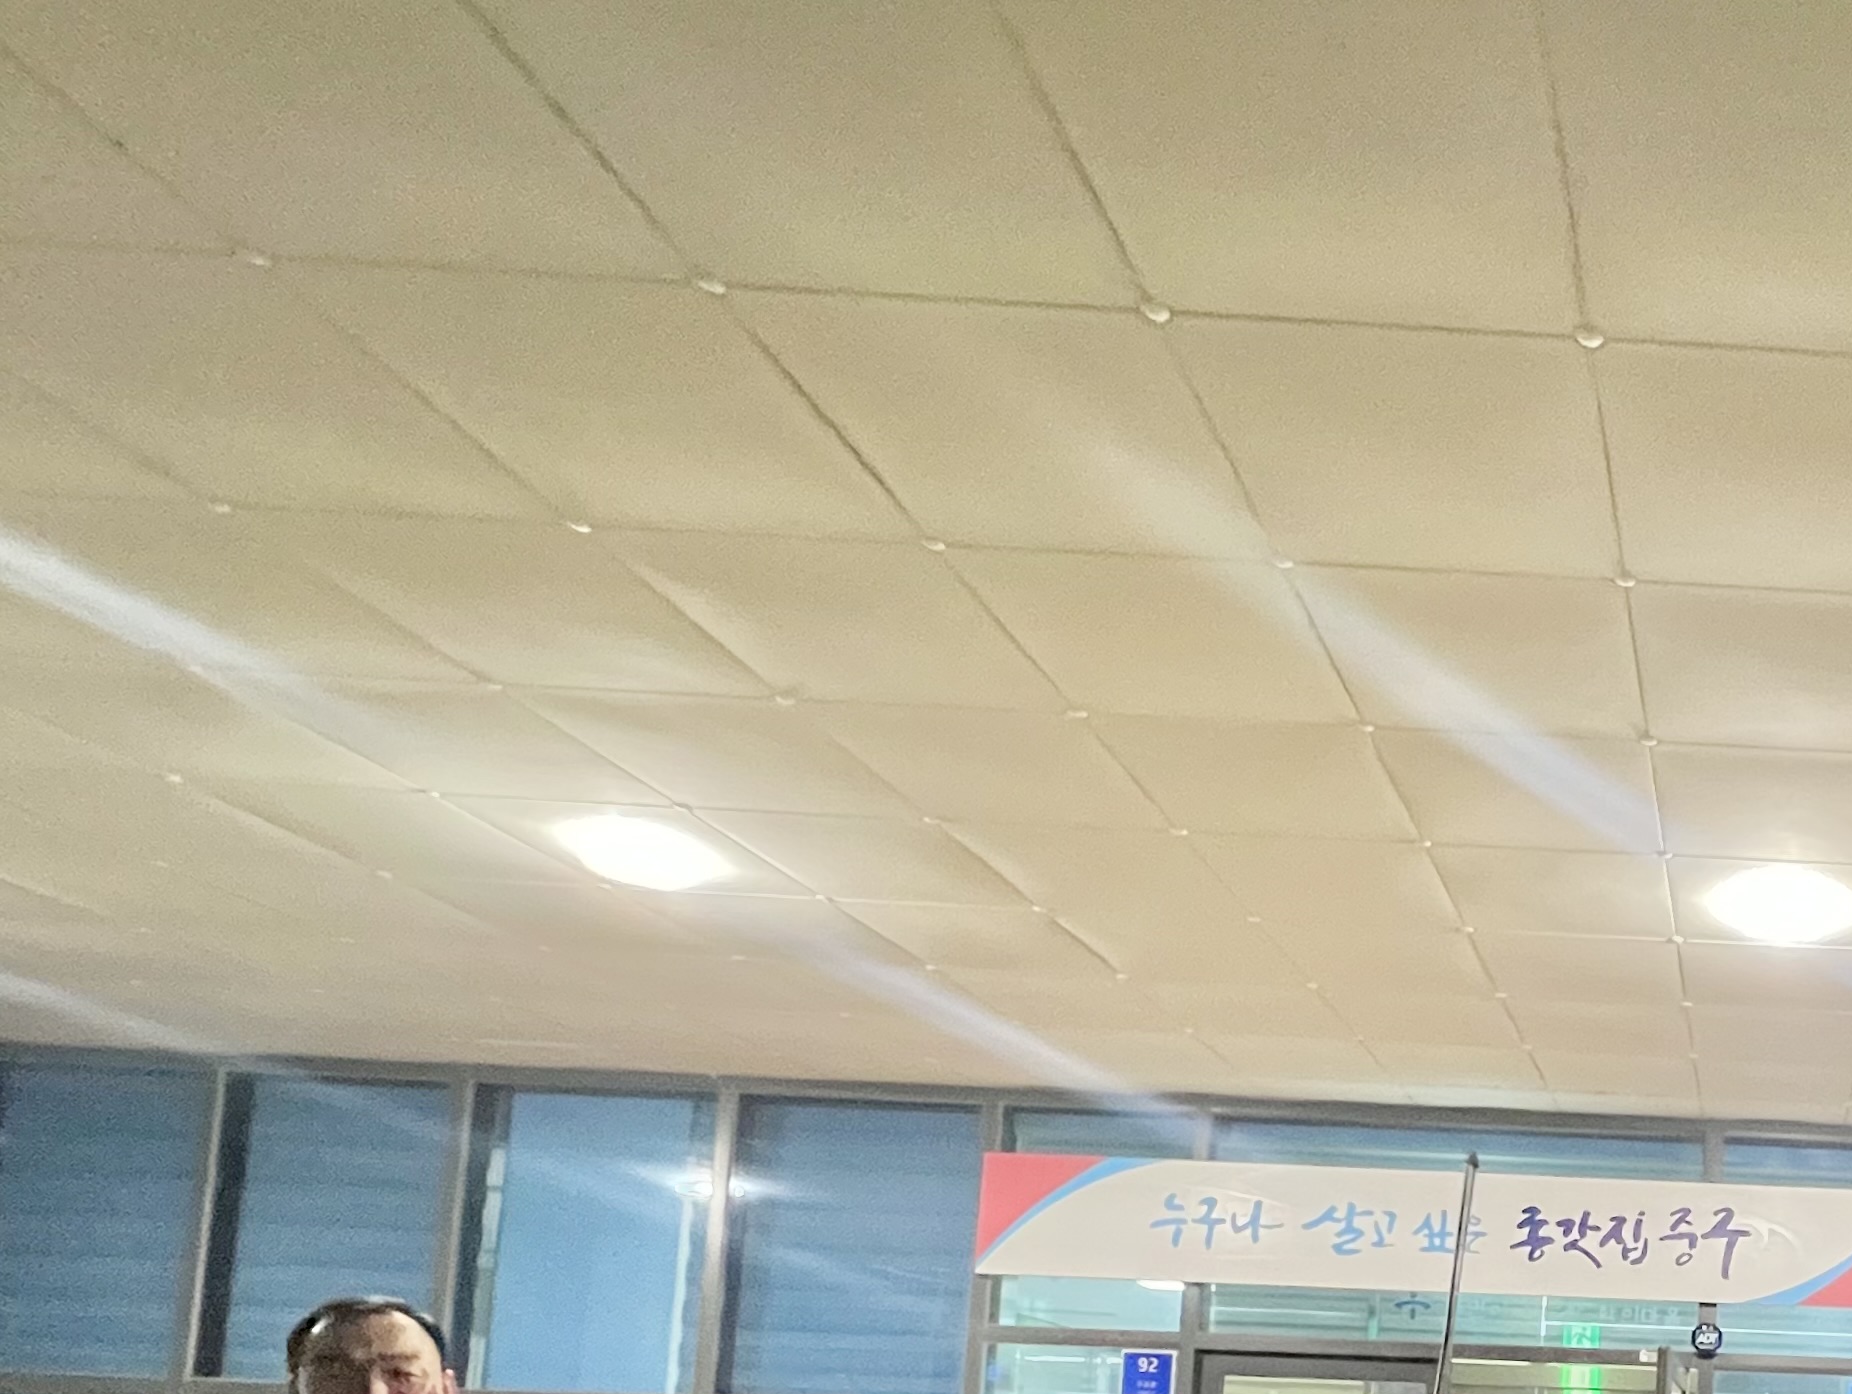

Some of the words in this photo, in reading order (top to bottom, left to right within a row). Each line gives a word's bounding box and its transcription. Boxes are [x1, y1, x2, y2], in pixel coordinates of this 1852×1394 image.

[1150, 1193, 1285, 1250] 누구나
[1301, 1202, 1398, 1255] 살고
[1510, 1206, 1648, 1268] 종갓집
[1659, 1207, 1752, 1280] 중구
[1137, 1356, 1159, 1373] 92
